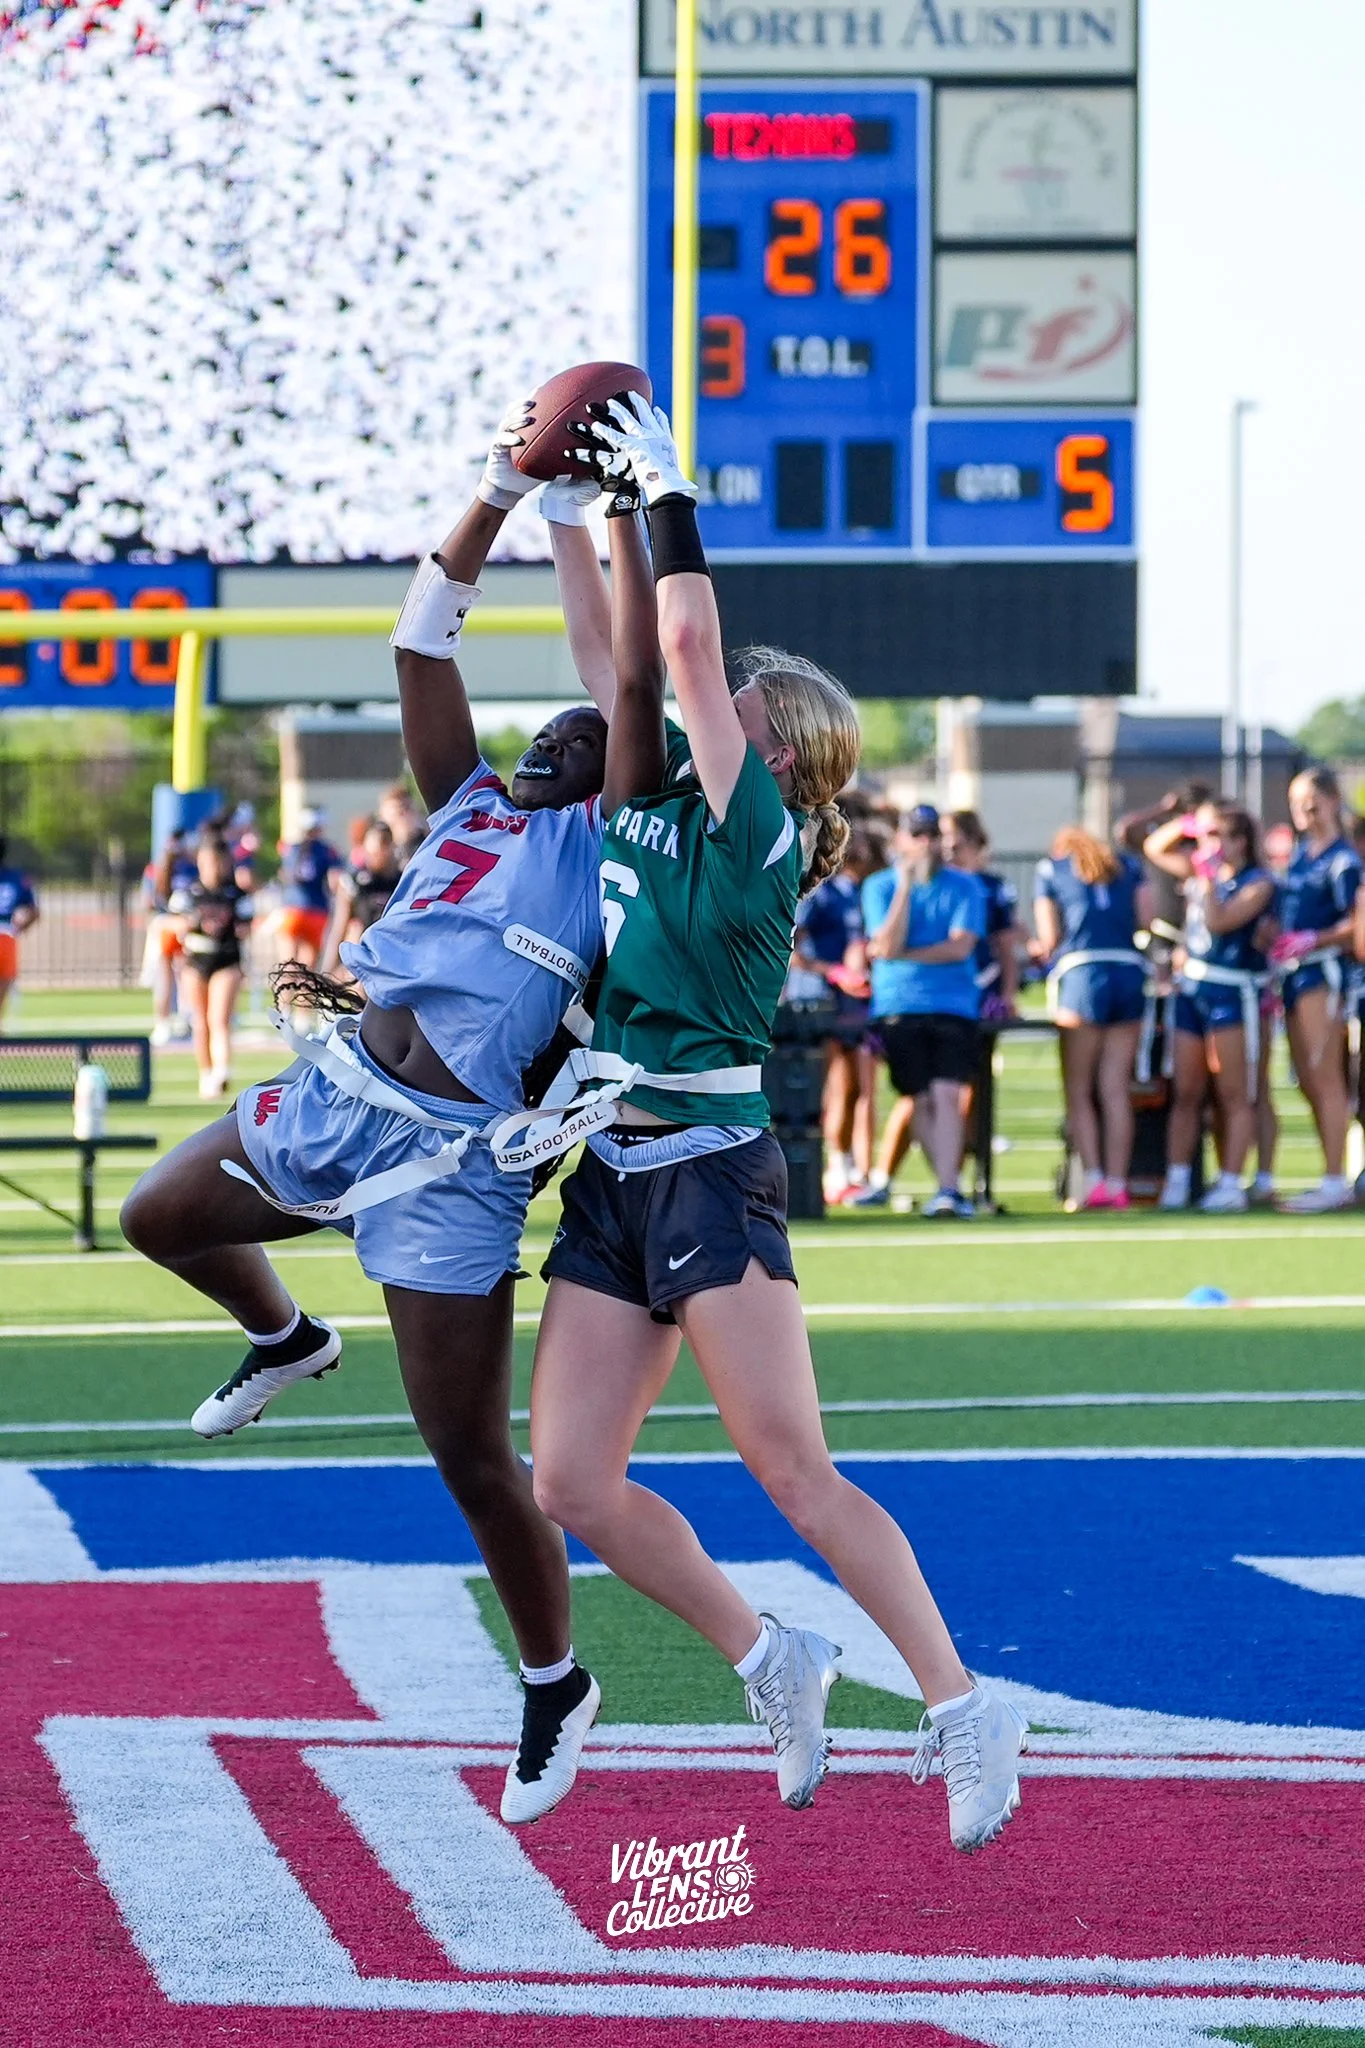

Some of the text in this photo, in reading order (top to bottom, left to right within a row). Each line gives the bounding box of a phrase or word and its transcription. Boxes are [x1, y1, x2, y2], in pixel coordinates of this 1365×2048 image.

[667, 0, 1117, 48] NORTH AUSTIN
[765, 197, 891, 295] 26
[1056, 434, 1113, 533] 5
[409, 838, 501, 910] 7
[615, 806, 680, 859] PARK
[599, 858, 641, 959] 6
